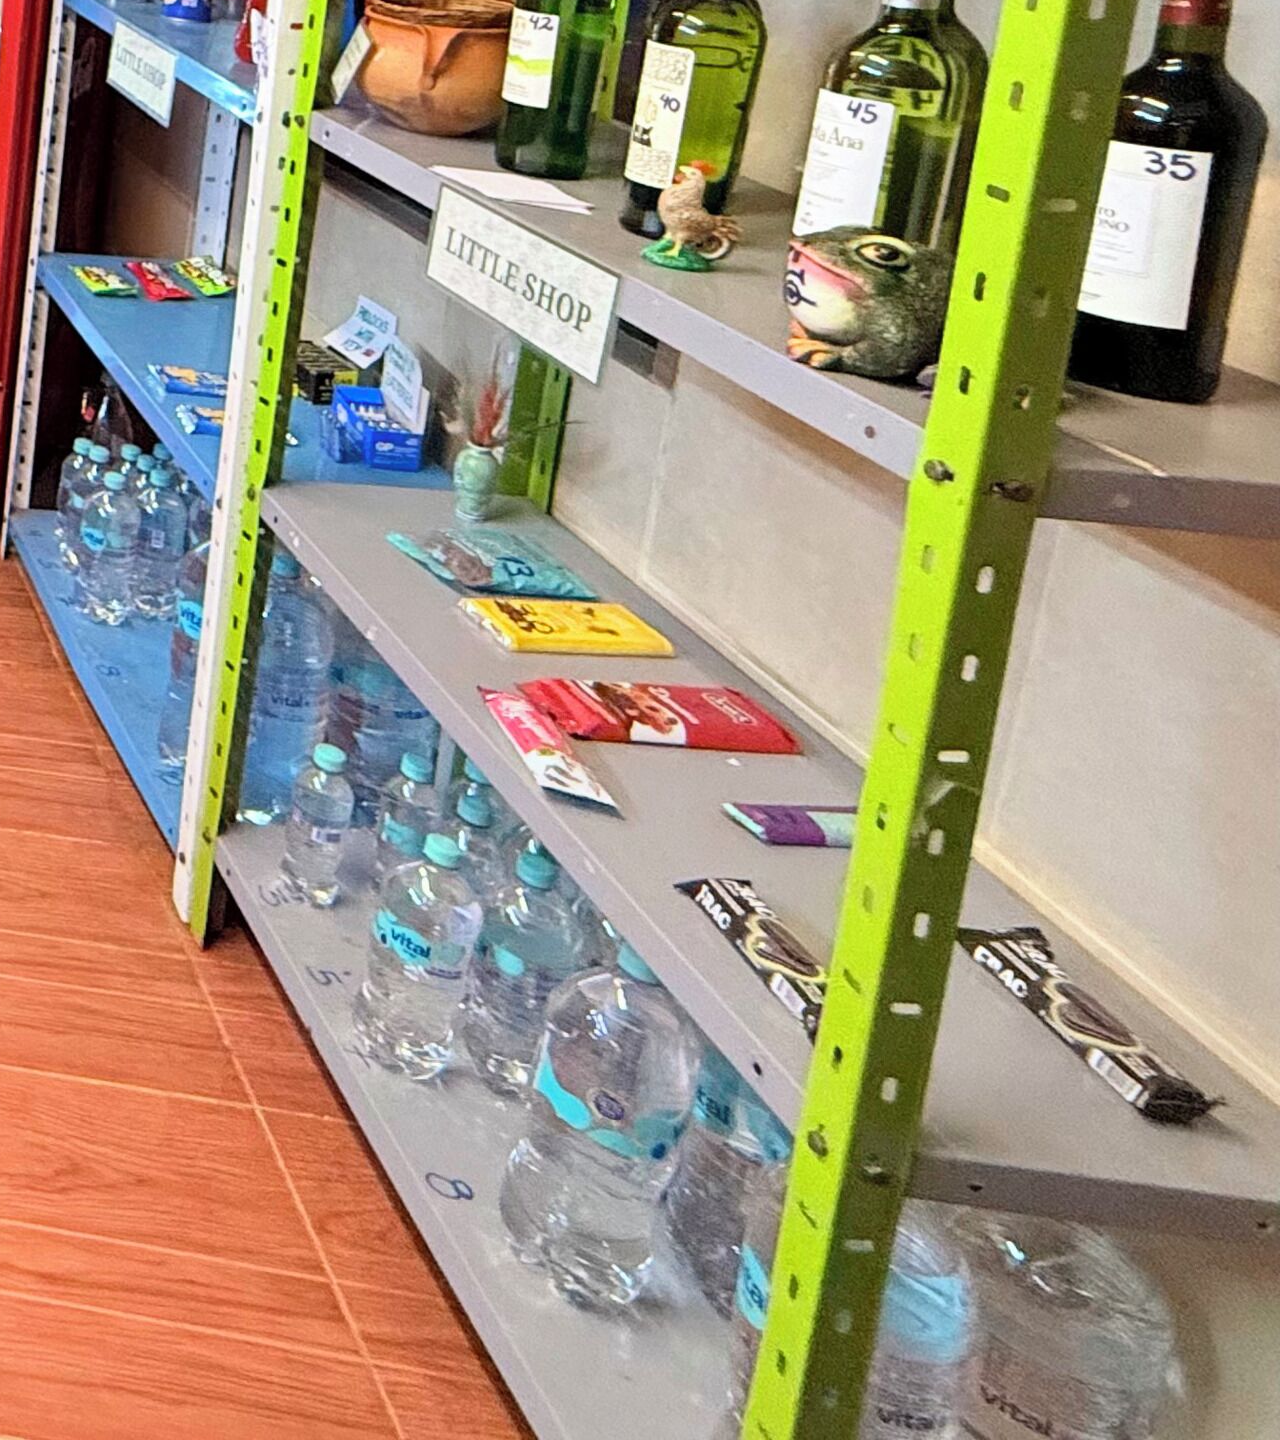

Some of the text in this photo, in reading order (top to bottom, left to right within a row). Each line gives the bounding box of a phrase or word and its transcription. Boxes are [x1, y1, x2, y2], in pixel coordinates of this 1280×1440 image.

[529, 14, 555, 32] 42
[660, 93, 682, 113] 40
[846, 98, 879, 125] 45
[1144, 150, 1198, 182] 35
[444, 226, 592, 333] LITTLE SHOP
[180, 608, 203, 627] vita
[694, 882, 733, 931] FRAC
[391, 928, 432, 959] vital
[973, 944, 1030, 999] FRAC
